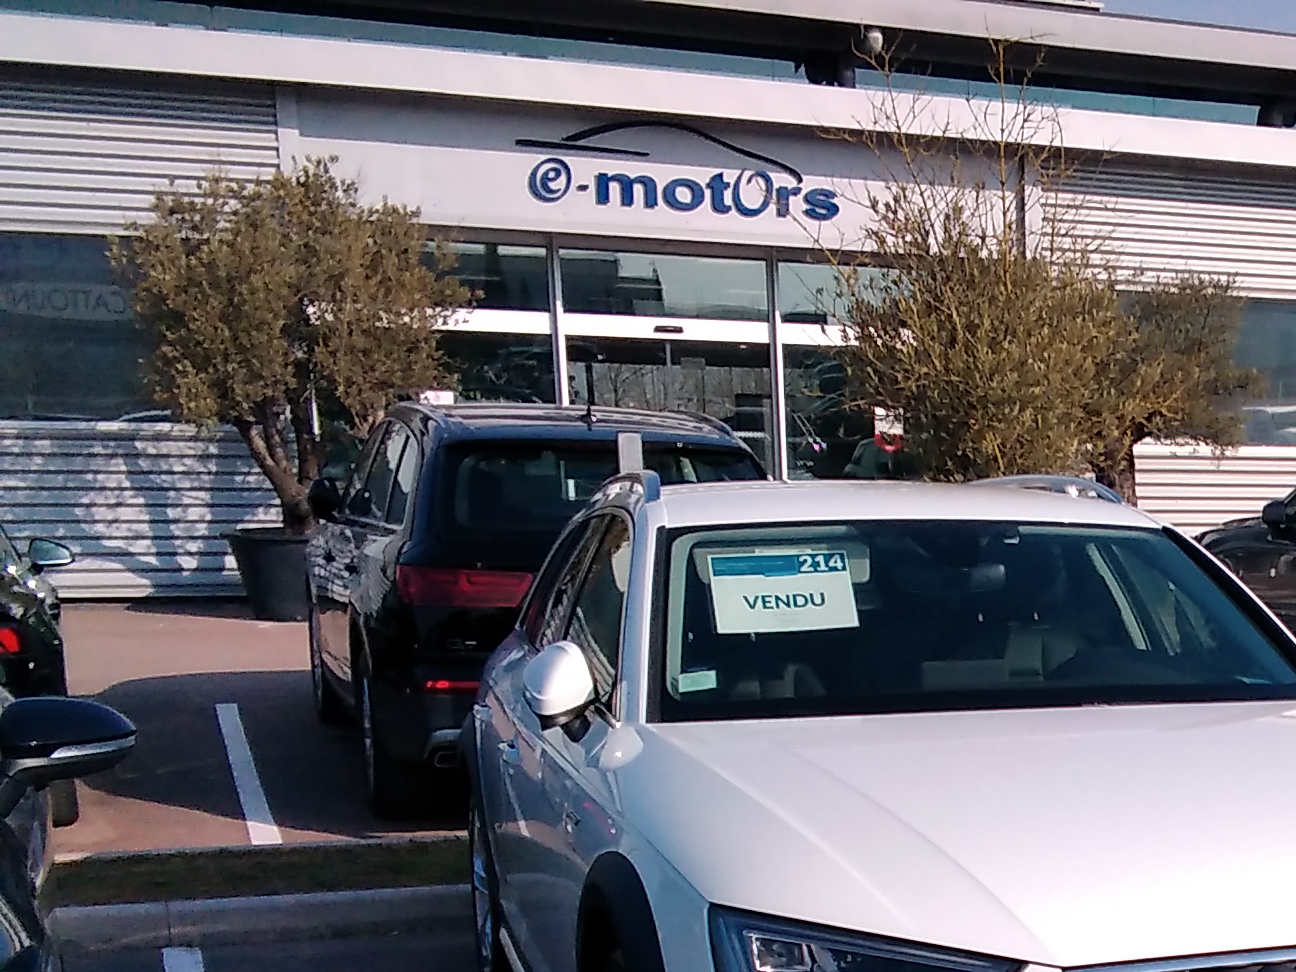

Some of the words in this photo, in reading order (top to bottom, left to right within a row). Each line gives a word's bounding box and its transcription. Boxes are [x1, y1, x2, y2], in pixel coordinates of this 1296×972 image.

[528, 157, 840, 221] e-motors
[799, 554, 844, 572] 214
[742, 591, 826, 610] VENDU
